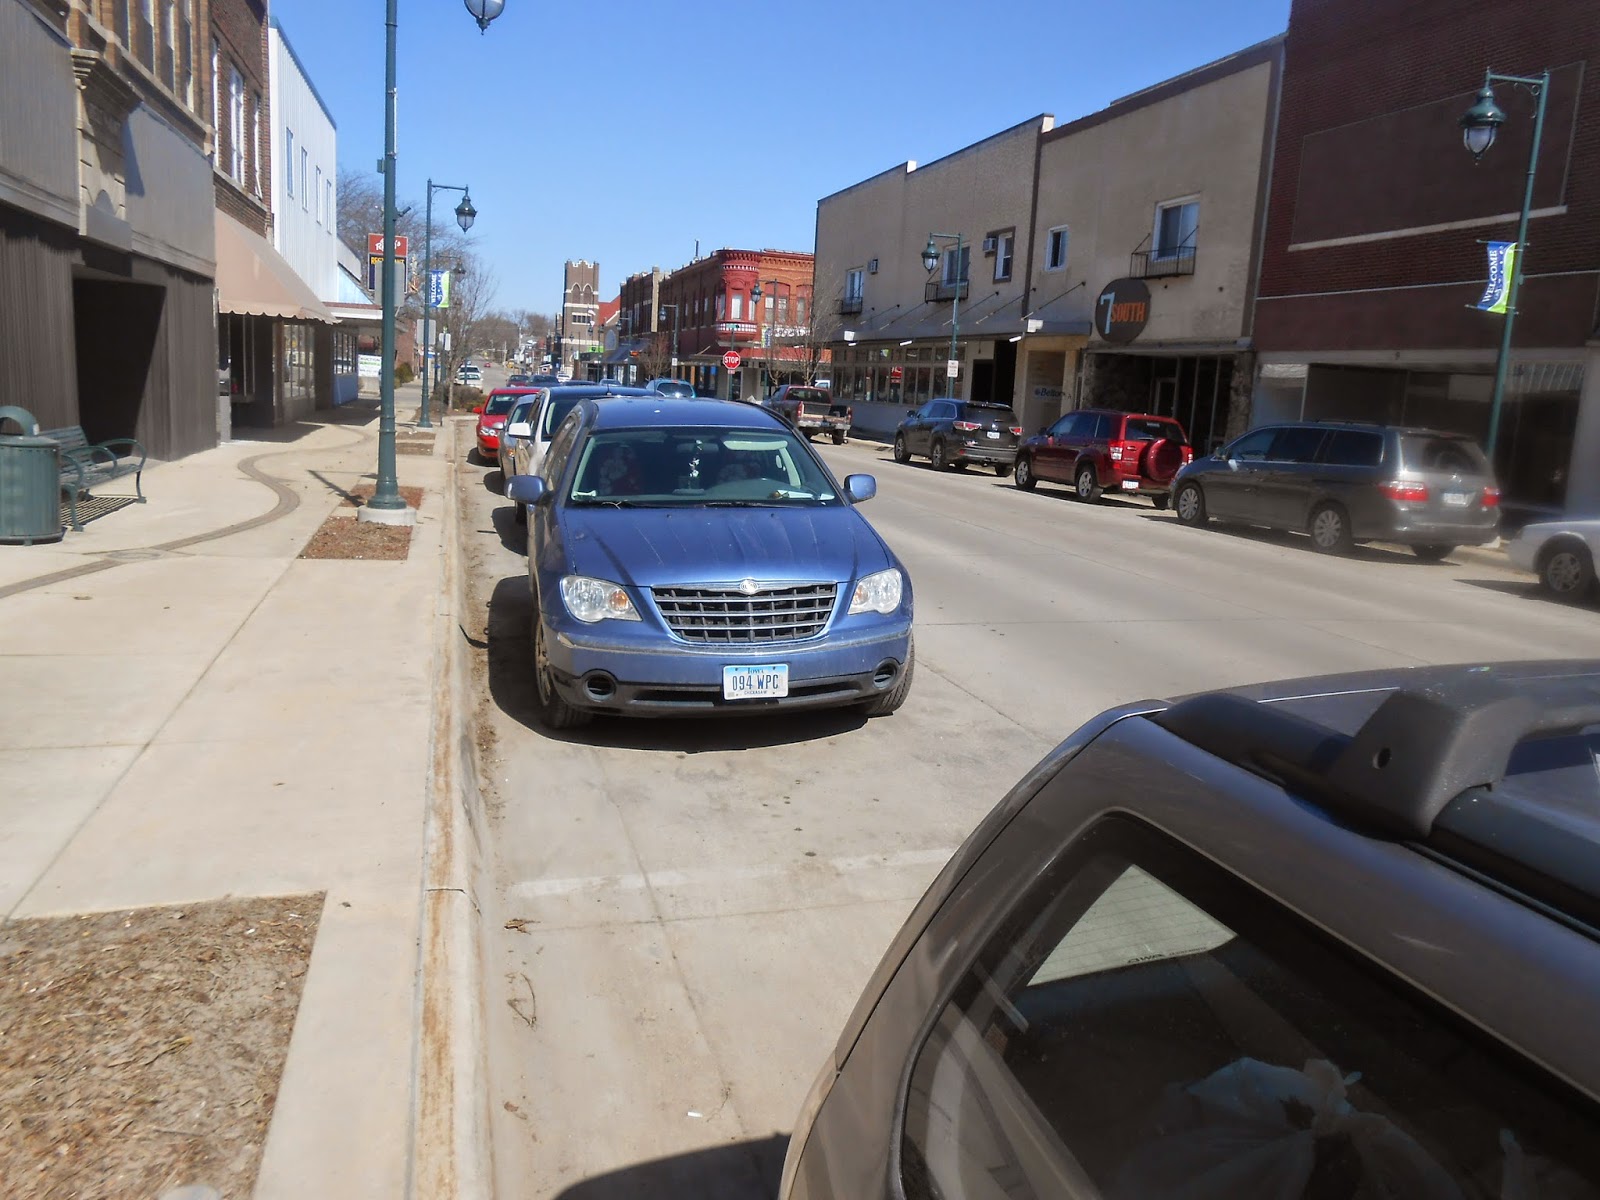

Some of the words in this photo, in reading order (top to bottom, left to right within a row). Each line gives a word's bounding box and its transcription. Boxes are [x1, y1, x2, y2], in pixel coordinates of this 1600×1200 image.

[1482, 250, 1498, 302] WELCOME
[1100, 292, 1115, 334] 7
[1112, 302, 1145, 322] SOUTH
[724, 356, 739, 364] STOP
[732, 675, 753, 691] 094
[757, 674, 779, 690] WPC
